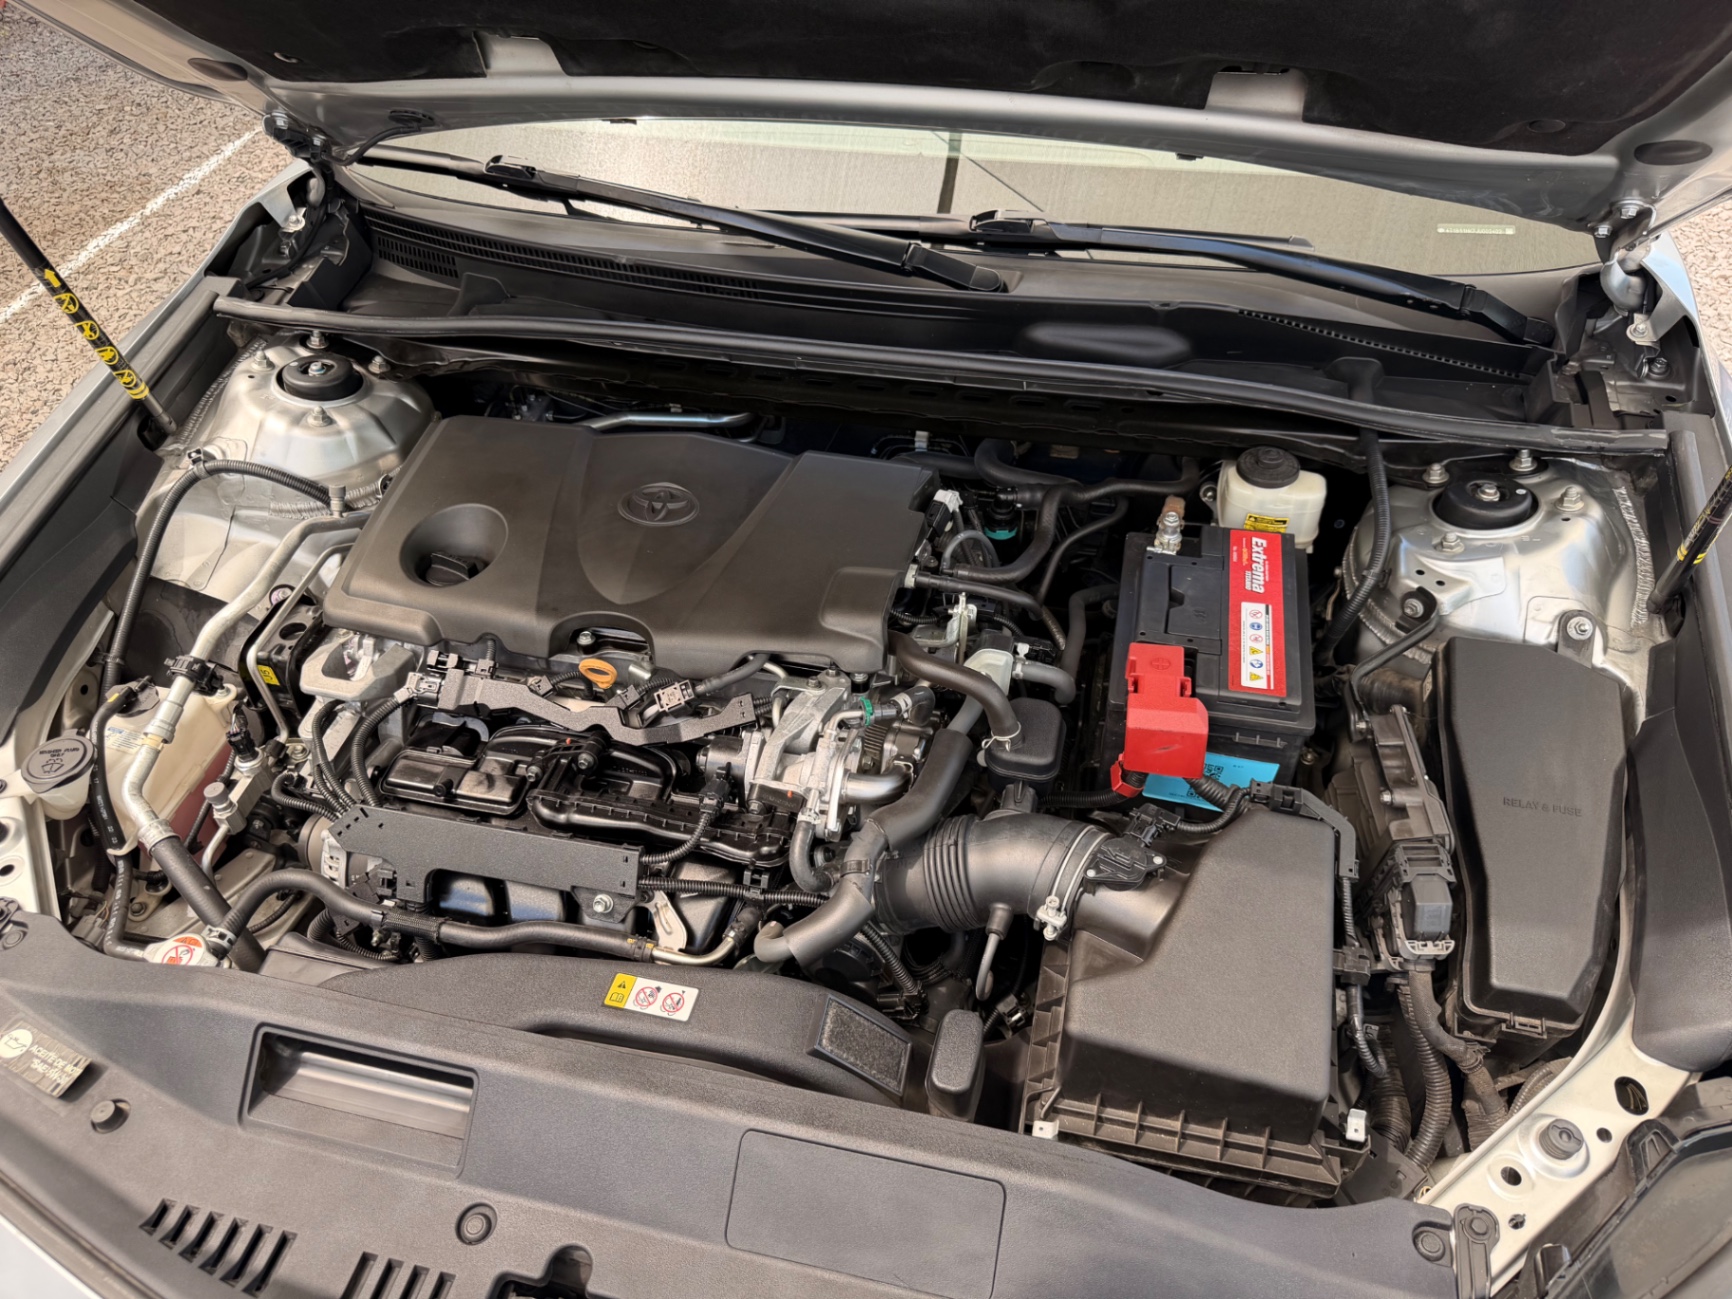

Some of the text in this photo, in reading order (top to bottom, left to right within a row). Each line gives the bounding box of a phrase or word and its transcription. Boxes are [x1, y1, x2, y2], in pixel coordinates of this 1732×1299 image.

[1251, 536, 1268, 594] Extrema
[1503, 796, 1583, 817] RELAY & FUSE
[29, 1045, 57, 1064] ACEITE
[53, 1058, 67, 1069] DE
